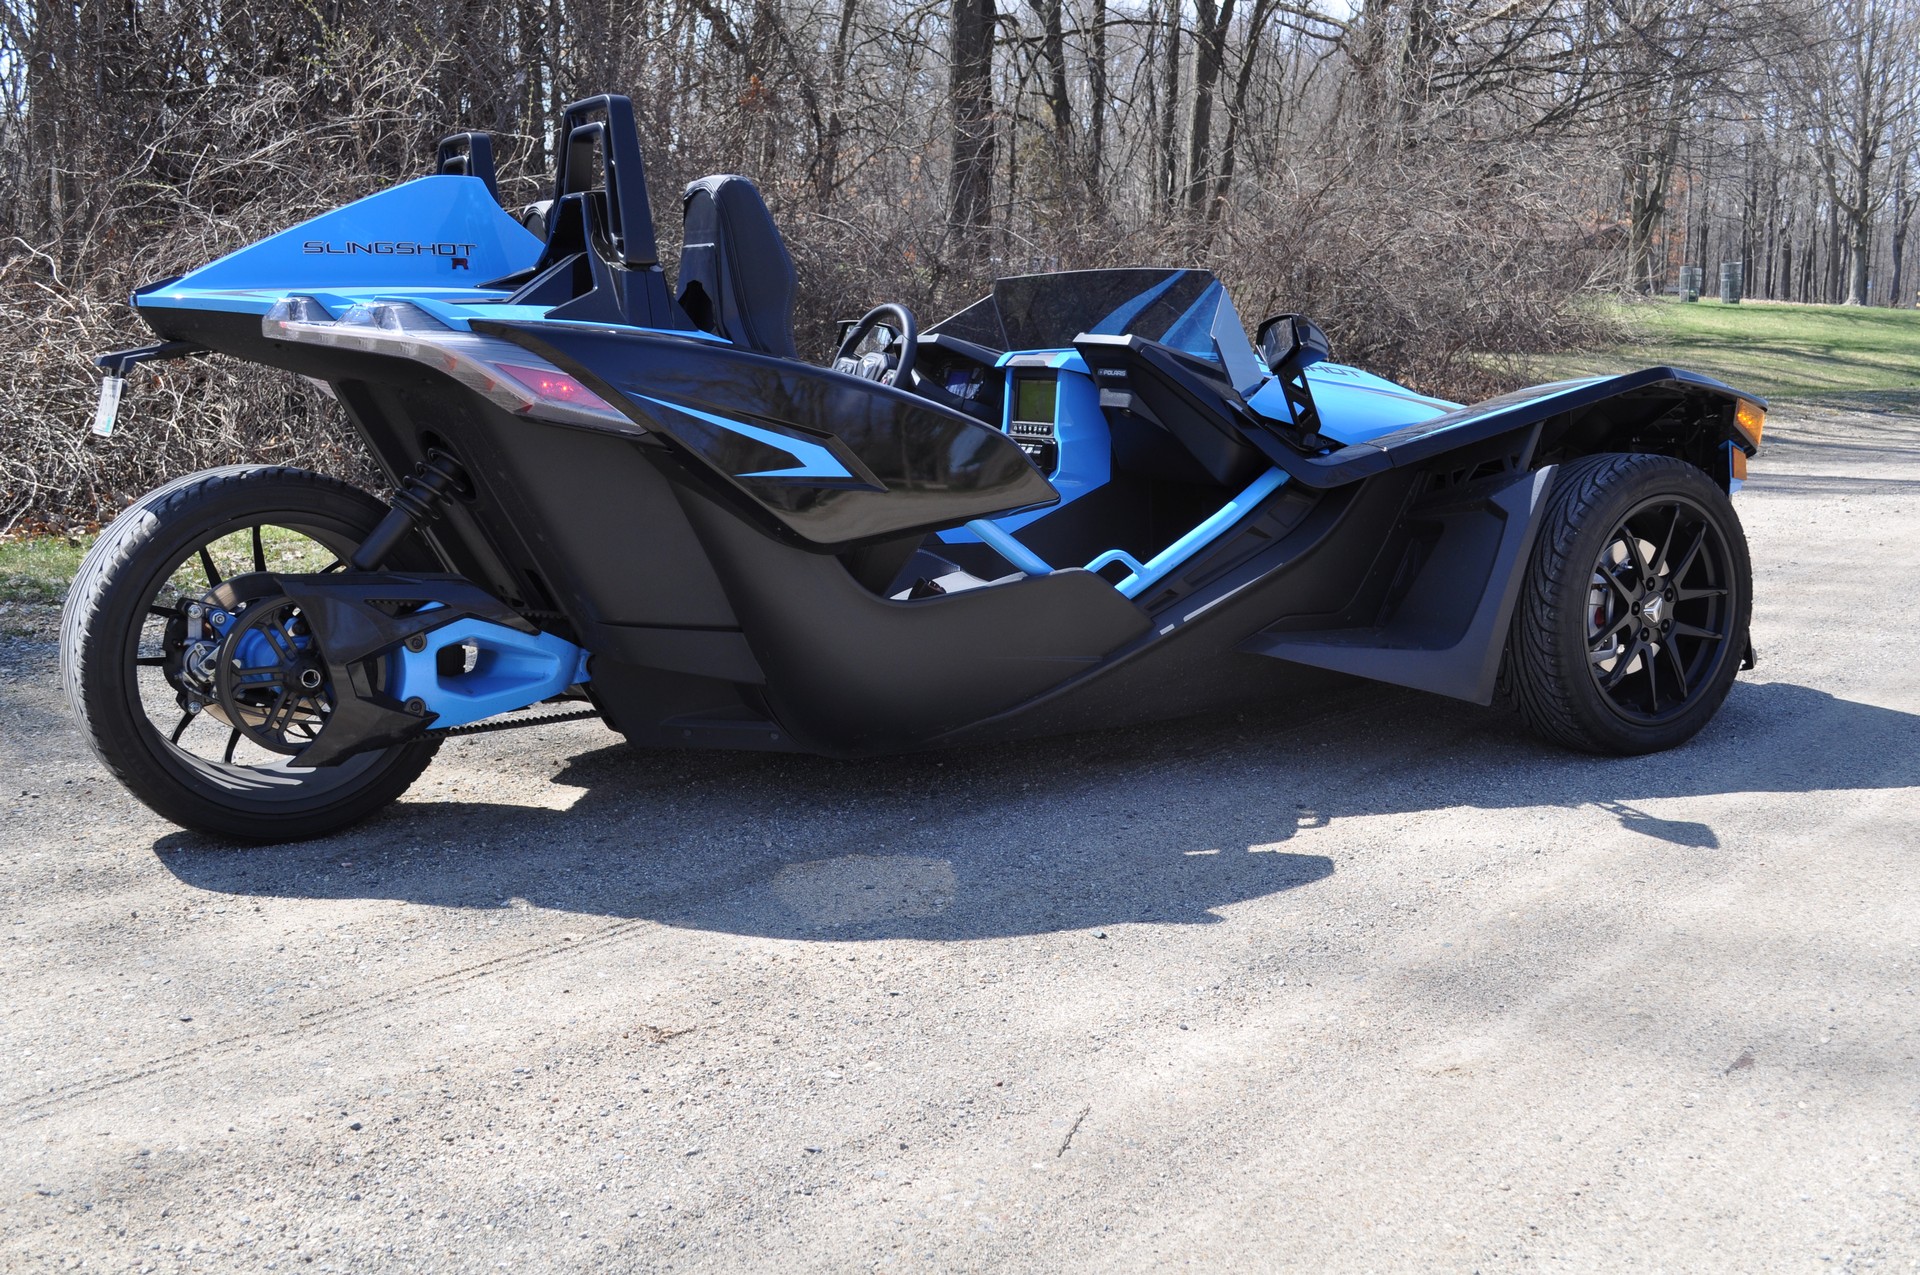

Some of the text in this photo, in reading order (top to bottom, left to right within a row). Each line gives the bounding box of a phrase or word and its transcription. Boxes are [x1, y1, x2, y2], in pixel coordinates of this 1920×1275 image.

[303, 241, 476, 256] SLINGSHOT
[451, 258, 469, 270] R
[1103, 369, 1126, 377] POLARIS
